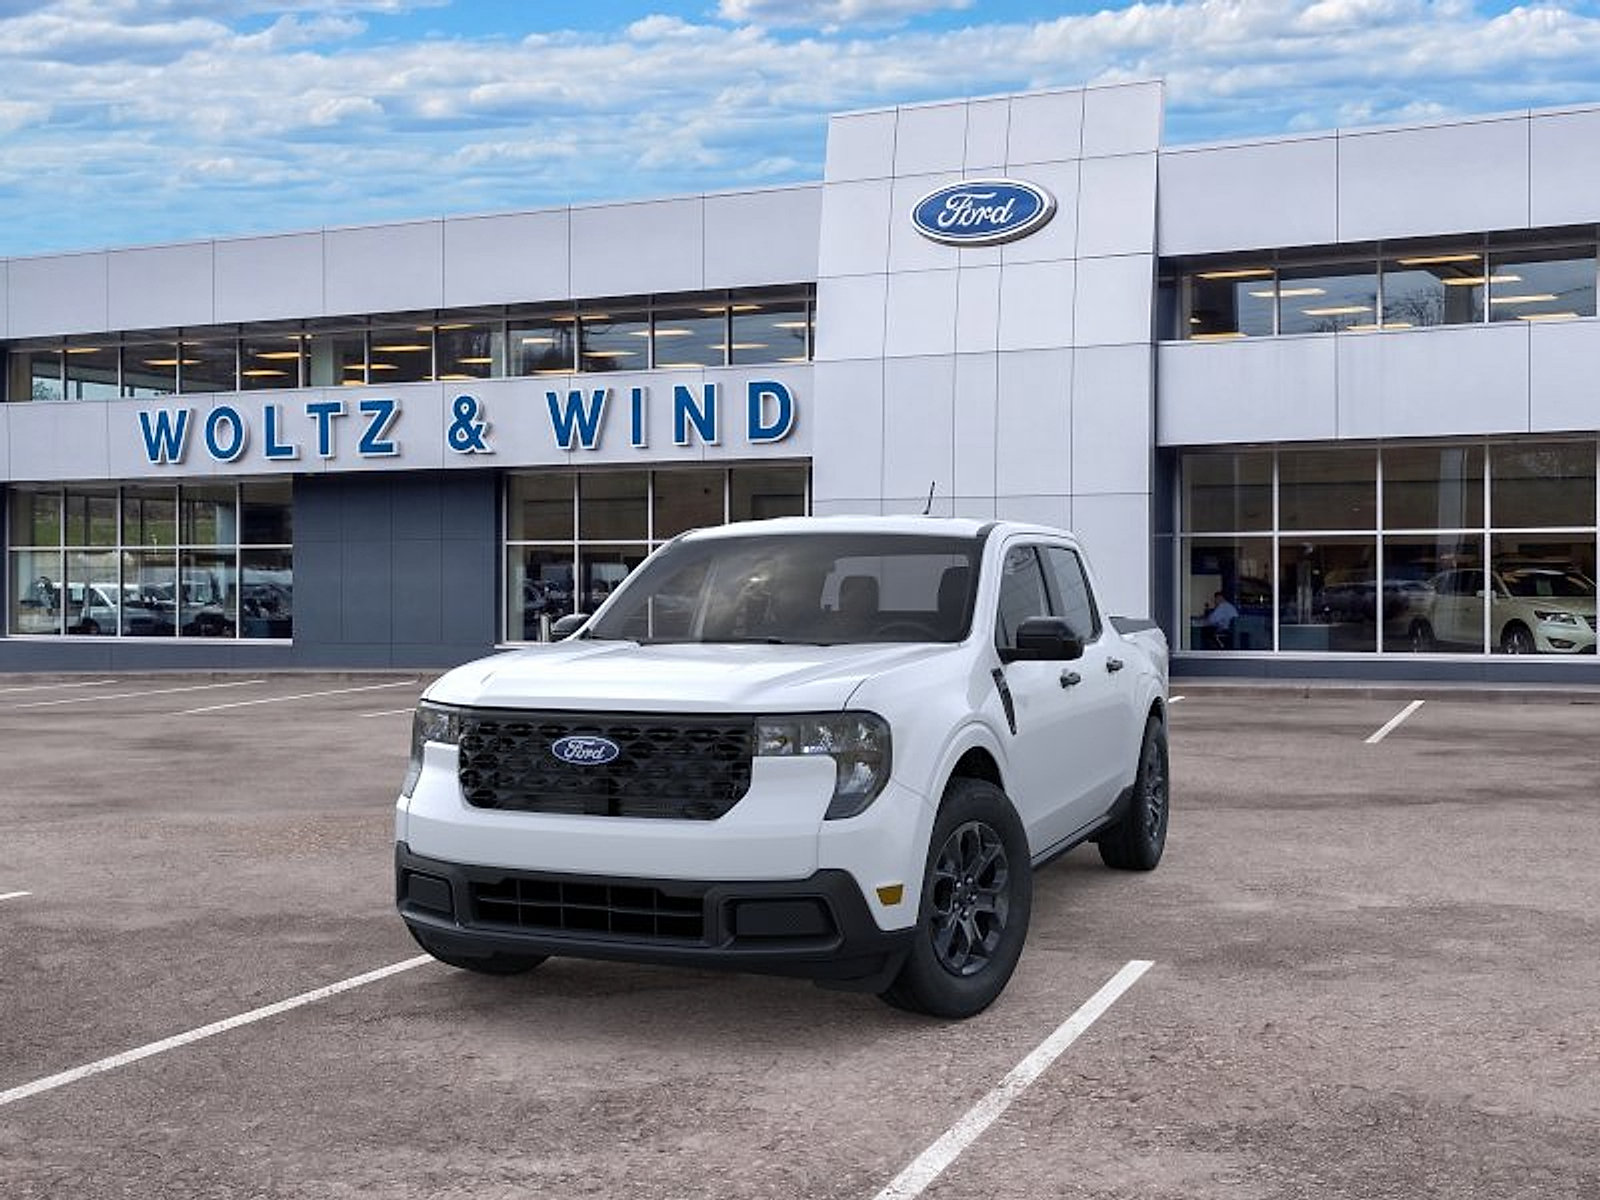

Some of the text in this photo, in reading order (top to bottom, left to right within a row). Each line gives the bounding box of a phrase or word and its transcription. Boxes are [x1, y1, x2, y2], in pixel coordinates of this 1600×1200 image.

[937, 192, 1015, 228] Ford
[138, 380, 796, 463] WOLTZ & WIND
[564, 740, 605, 759] Ford
